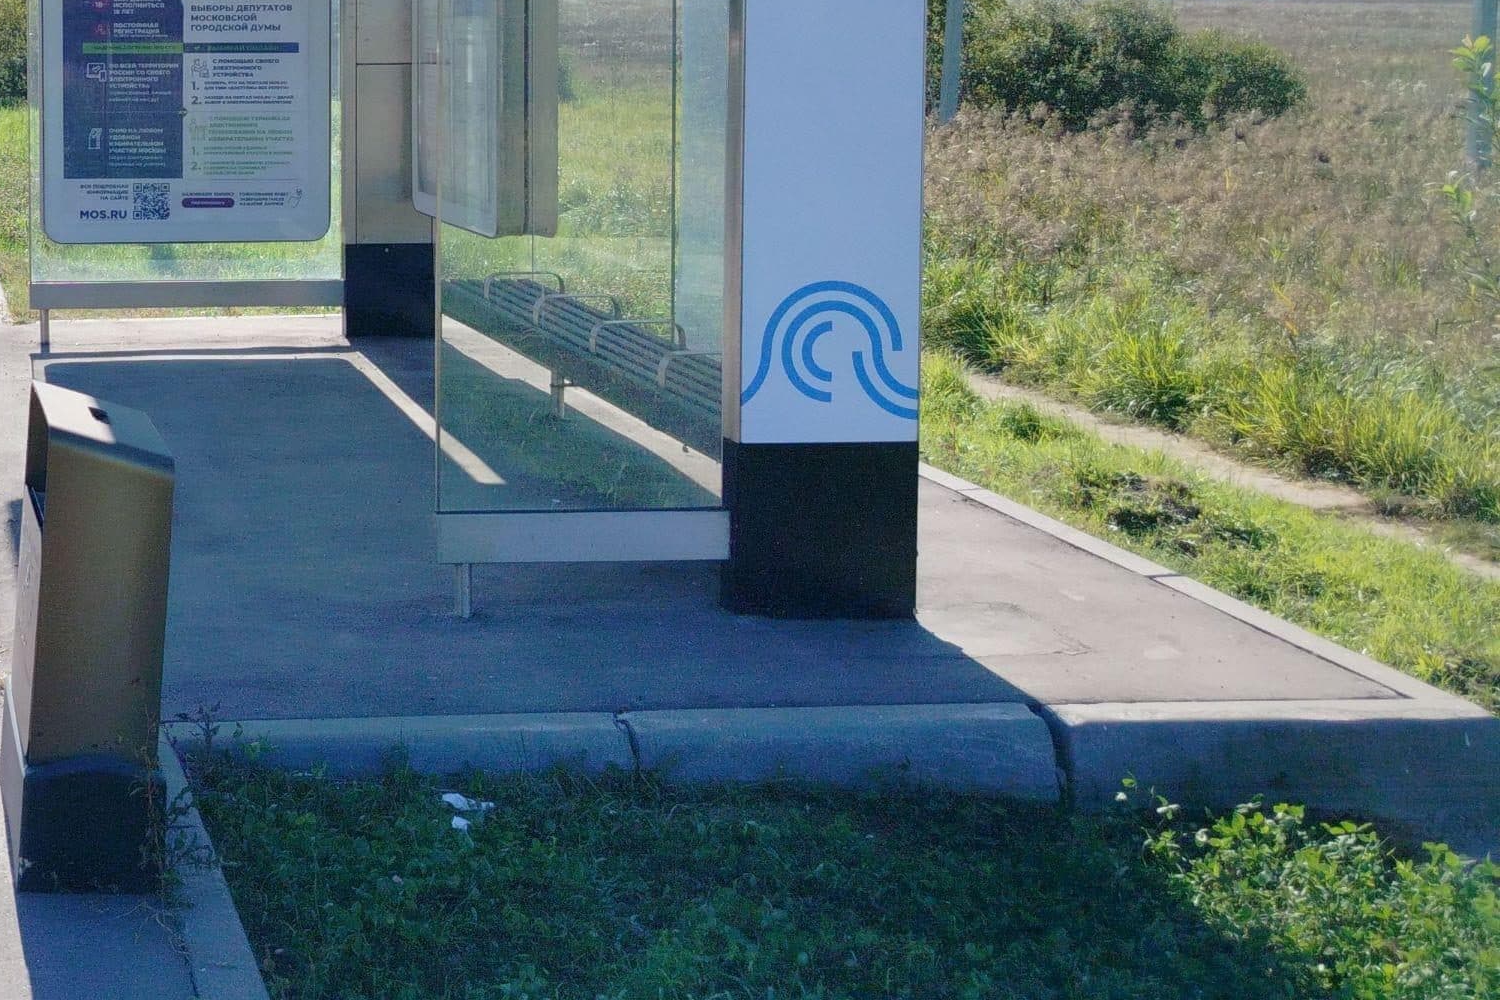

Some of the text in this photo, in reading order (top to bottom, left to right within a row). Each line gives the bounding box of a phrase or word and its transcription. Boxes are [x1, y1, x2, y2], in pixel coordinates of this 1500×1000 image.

[190, 4, 292, 12] ВЫБОРЫ ДЕПУТАТОВ
[190, 13, 257, 21] МОСКОВСКОЙ
[190, 23, 248, 32] ГОРОДСКОЙ
[191, 96, 202, 104] 2.
[80, 210, 127, 219] MOS.RU
